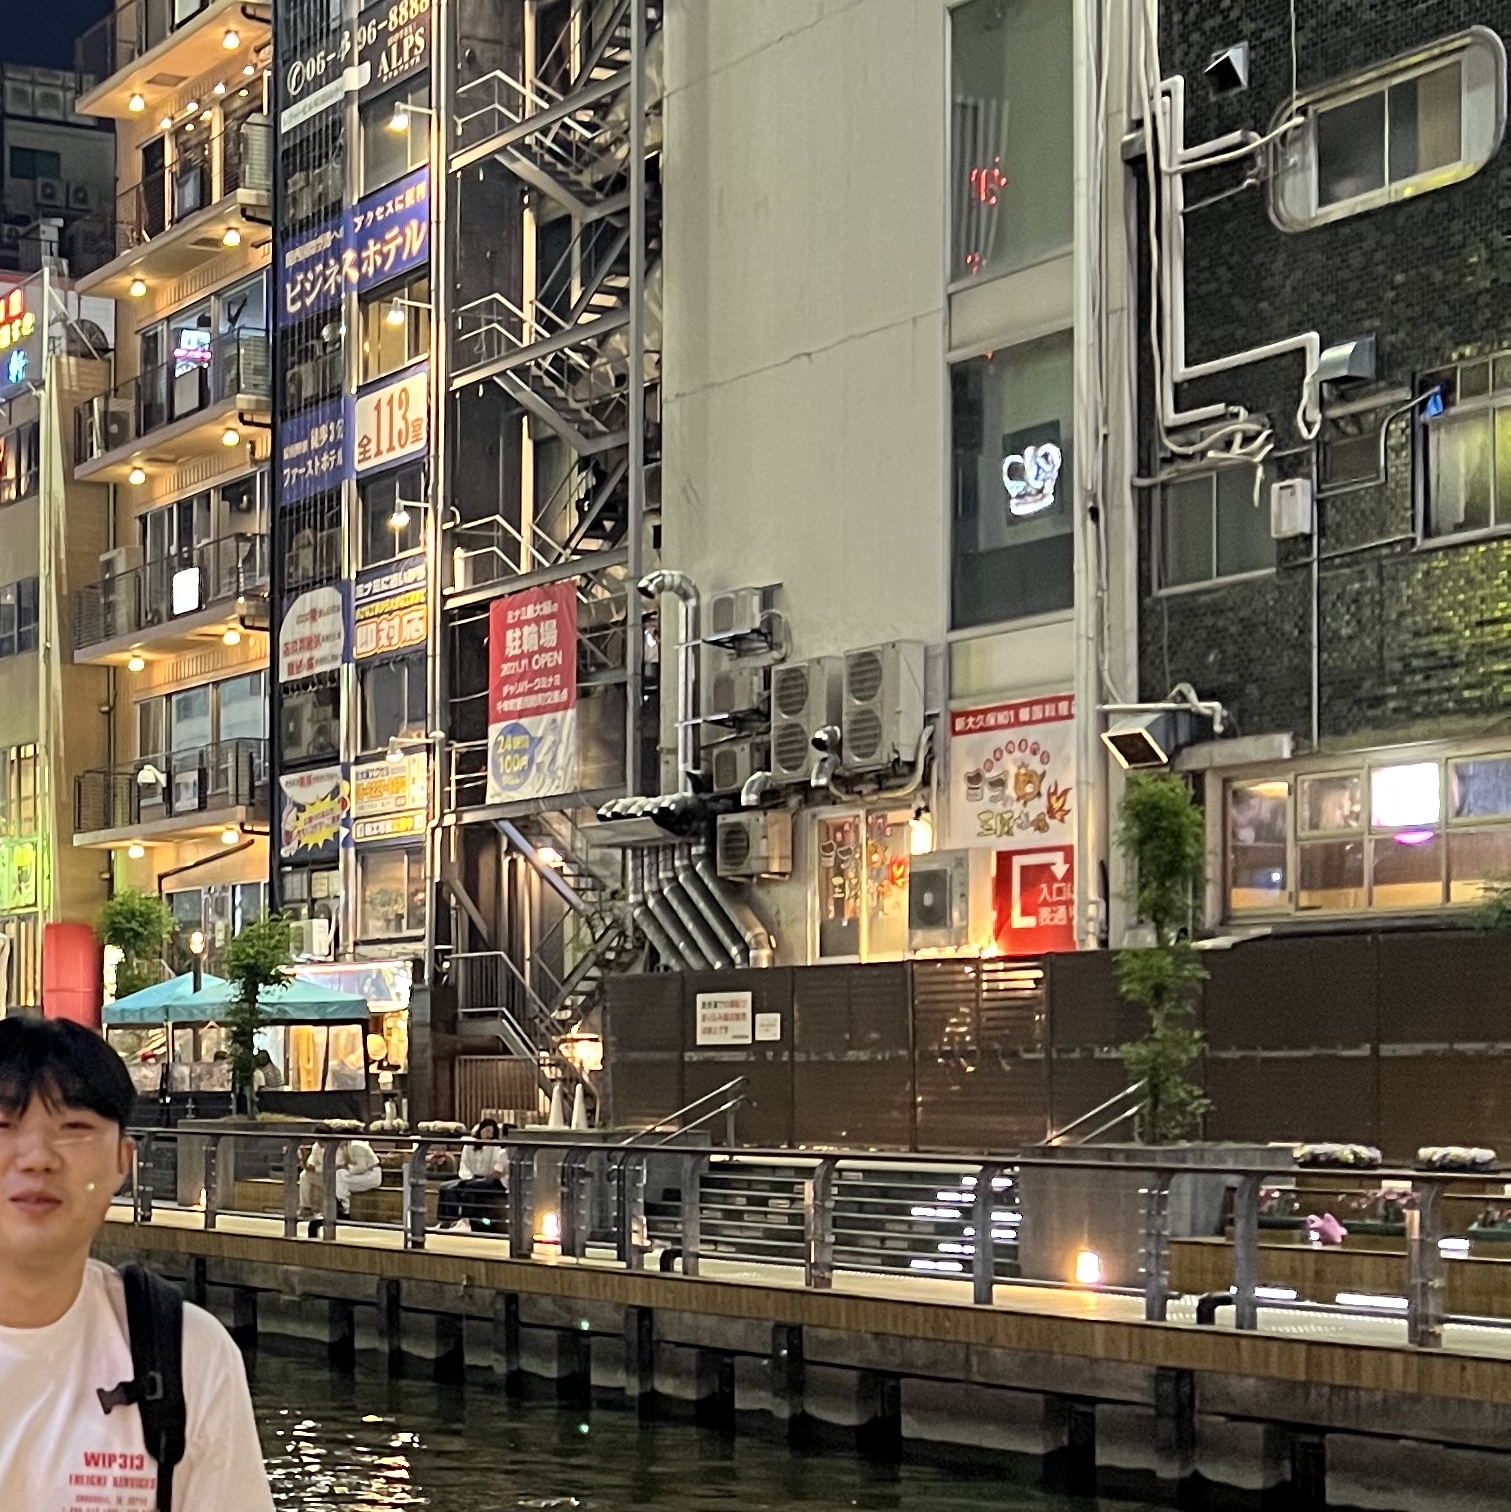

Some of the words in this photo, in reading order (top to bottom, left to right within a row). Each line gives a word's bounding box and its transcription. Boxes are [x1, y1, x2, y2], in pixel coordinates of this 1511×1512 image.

[377, 27, 425, 78] ALPS
[286, 218, 428, 313] ビジネスホテル
[358, 387, 424, 464] 全113室
[505, 619, 557, 657] 駐輪場
[531, 650, 562, 670] OPEN
[84, 1452, 144, 1470] WIP313
